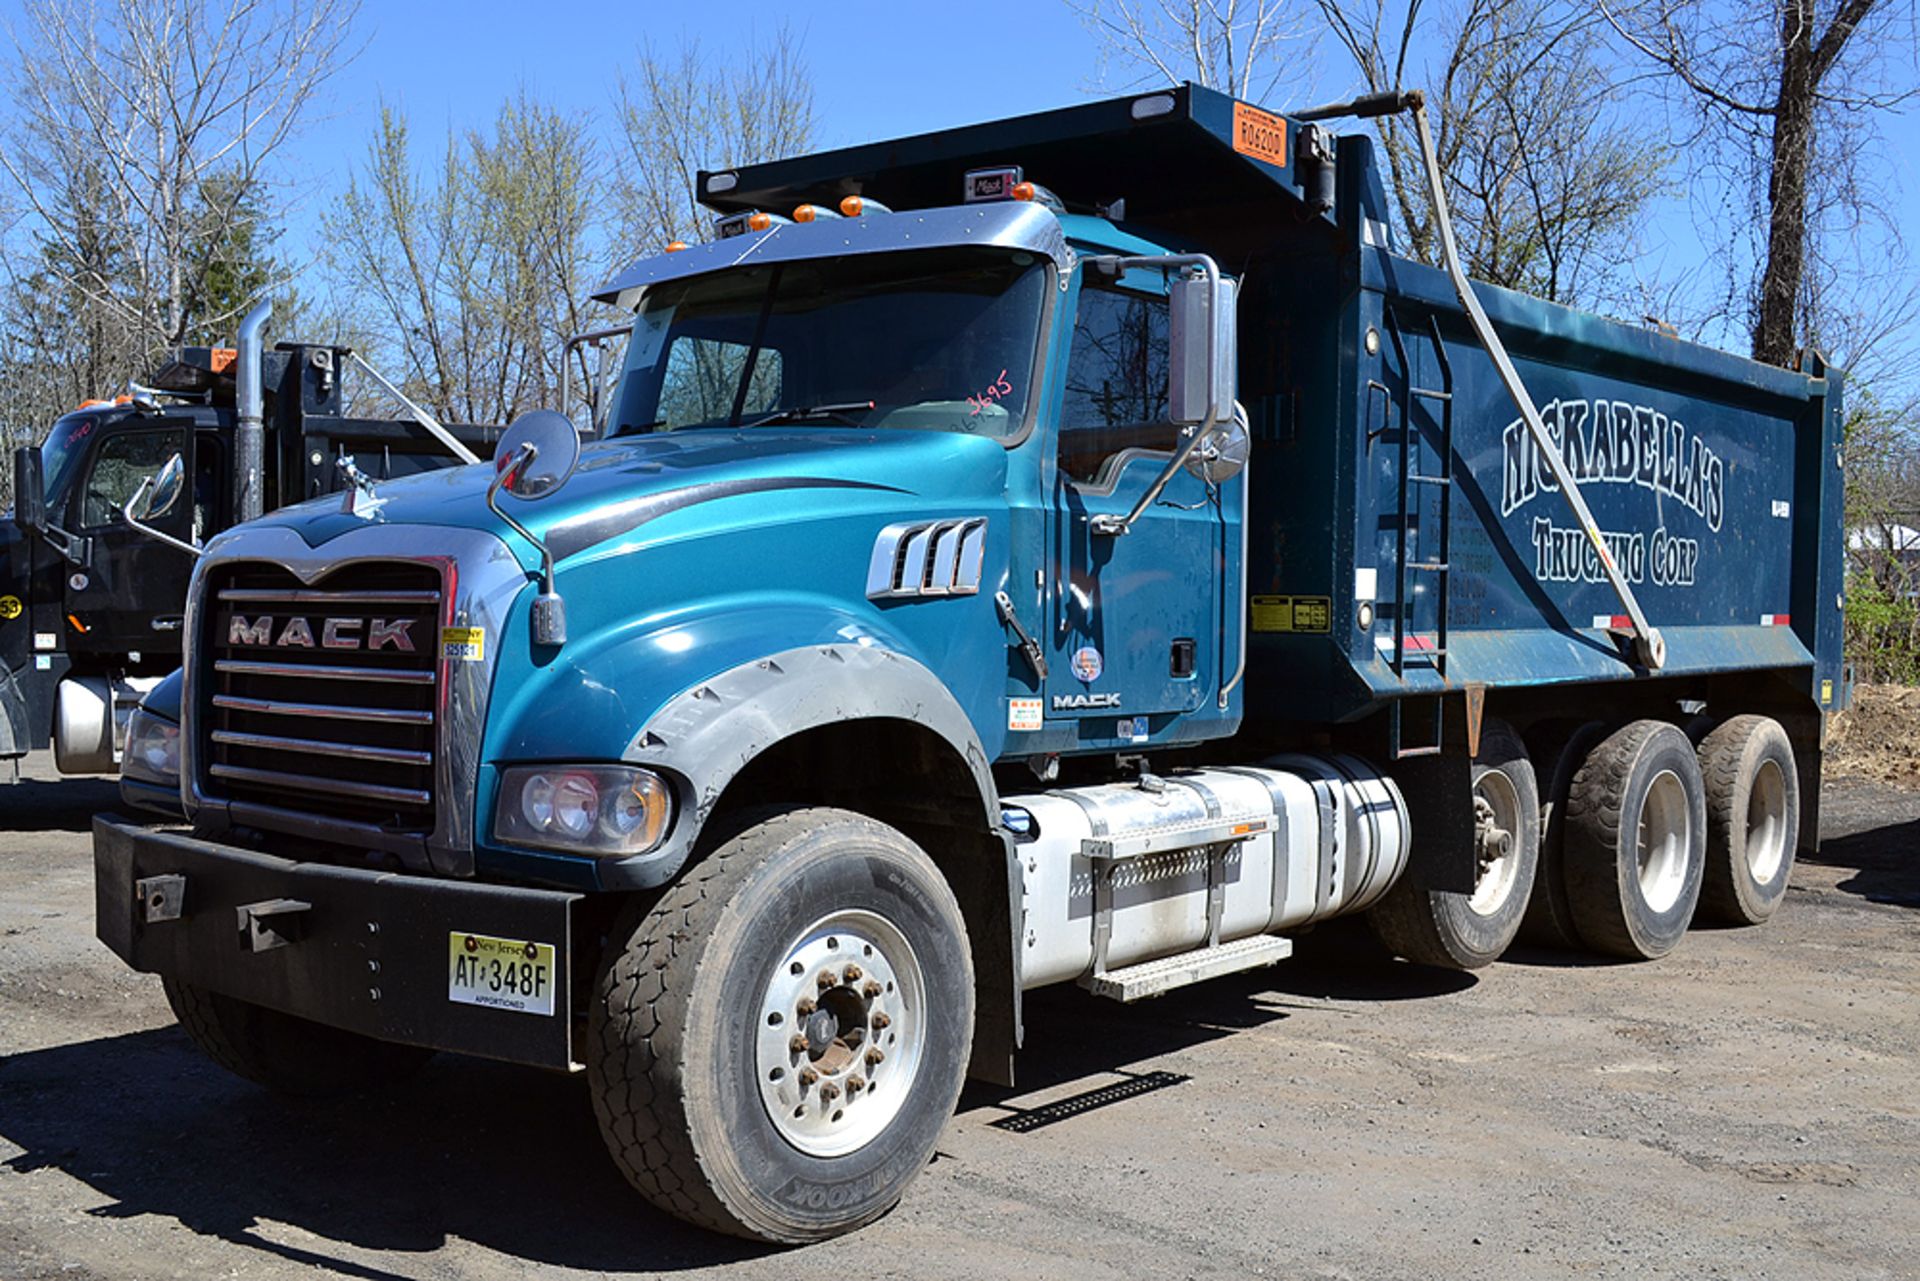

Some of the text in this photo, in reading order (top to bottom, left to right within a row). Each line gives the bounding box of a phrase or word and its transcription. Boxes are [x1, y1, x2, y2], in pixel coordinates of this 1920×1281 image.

[964, 368, 1012, 416] 3695
[228, 615, 417, 651] MACK
[1052, 693, 1121, 711] MACK
[498, 942, 526, 959] Jersey
